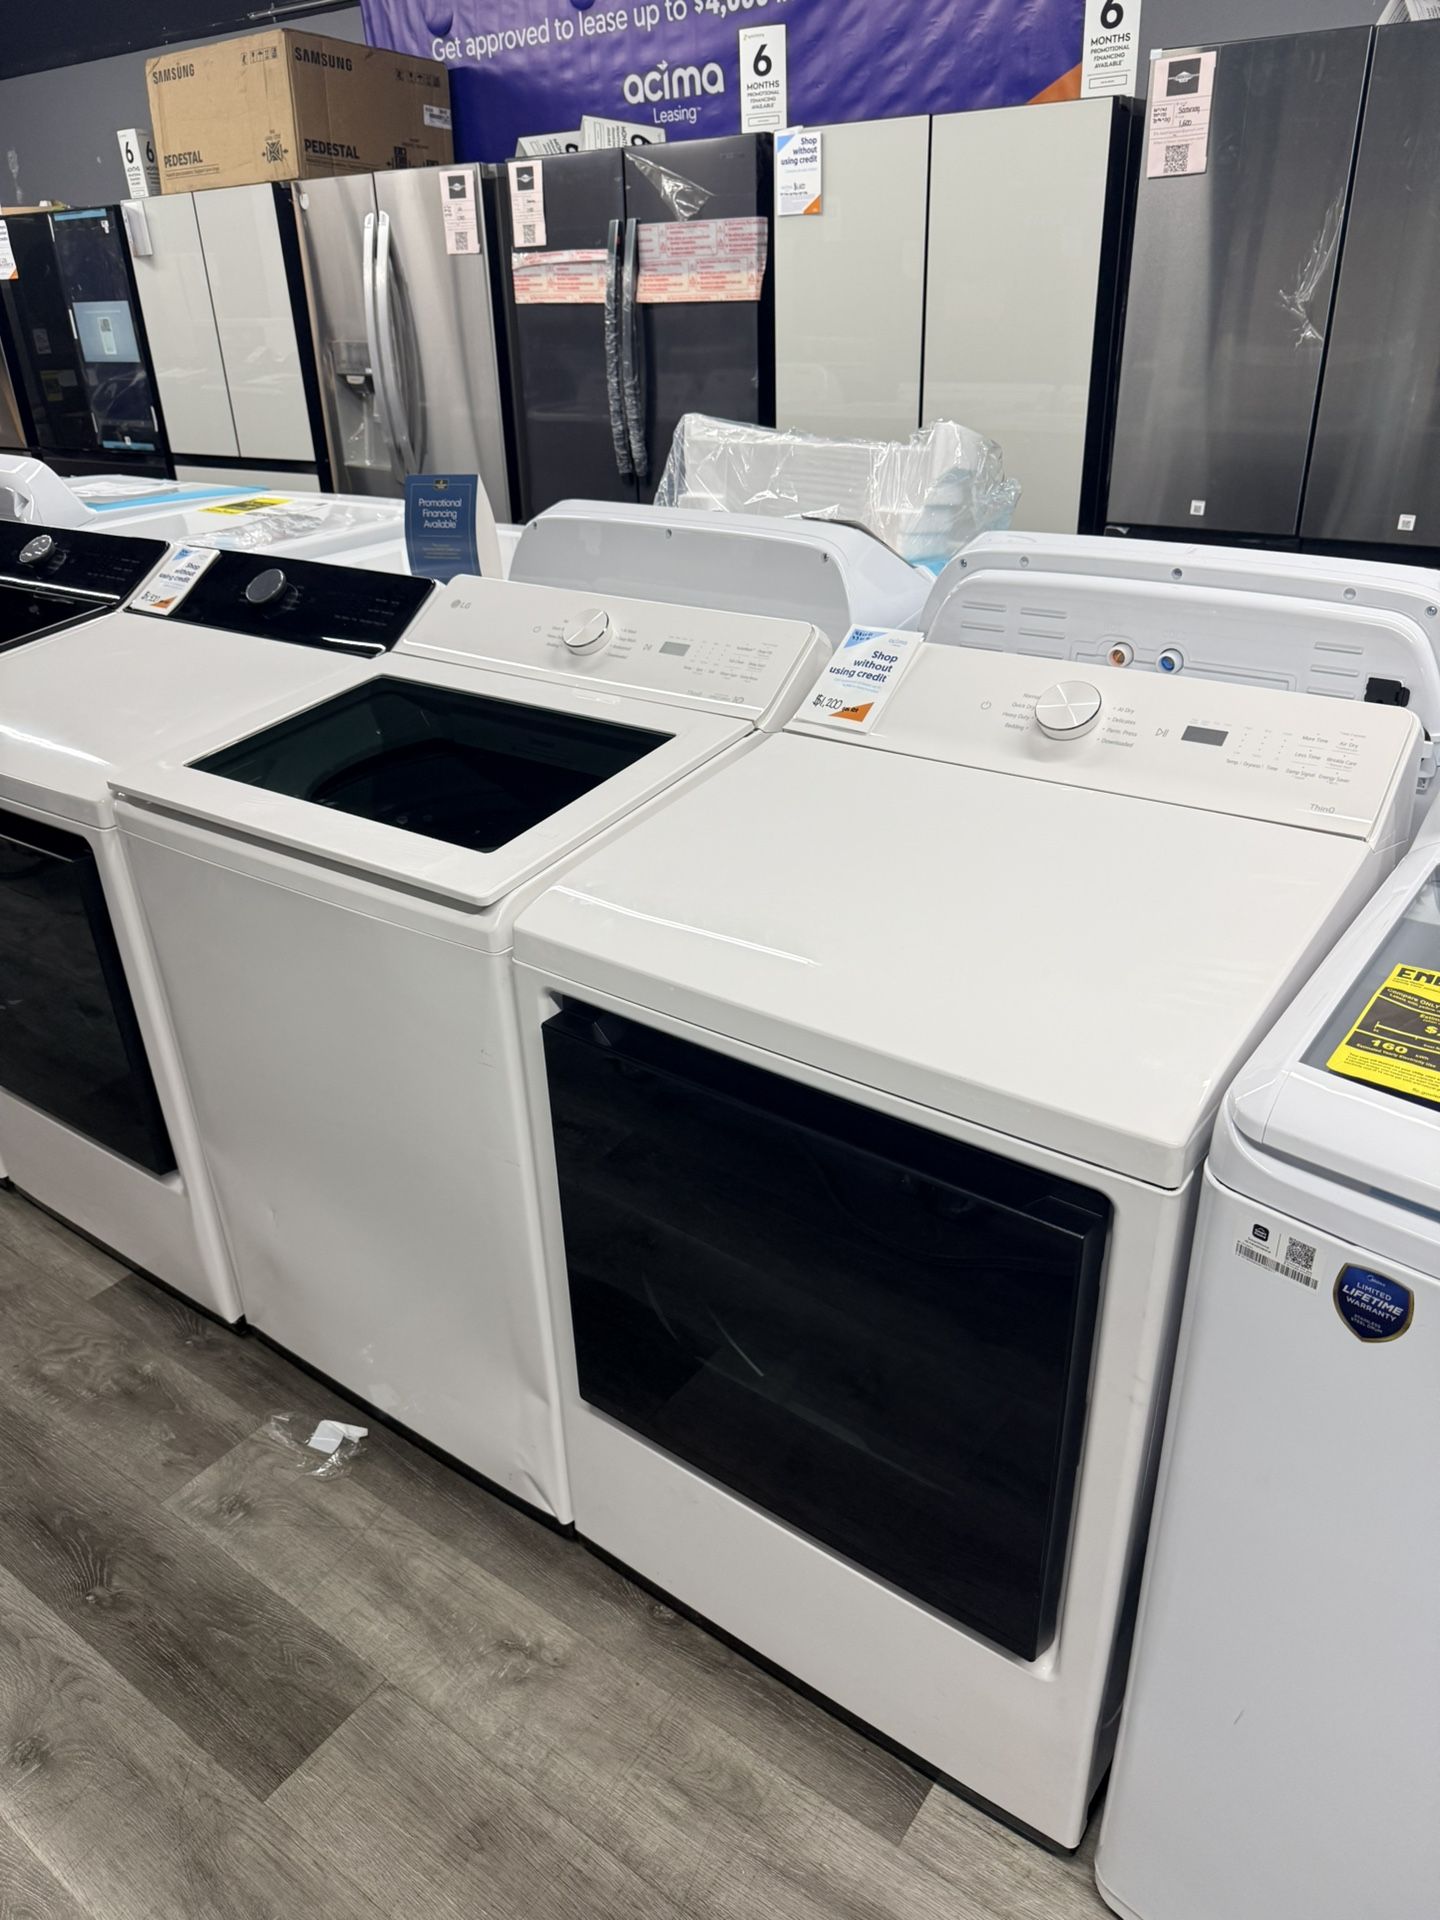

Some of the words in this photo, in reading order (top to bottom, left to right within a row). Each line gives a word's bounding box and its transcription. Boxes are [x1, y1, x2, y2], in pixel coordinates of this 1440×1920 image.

[1100, 0, 1124, 29] 6
[432, 37, 463, 61] Get
[466, 18, 550, 60] approved
[554, 18, 574, 40] to
[578, 11, 629, 36] lease
[634, 5, 660, 31] up
[665, 1, 687, 21] to
[1090, 33, 1131, 46] MONTHS
[1090, 45, 1130, 54] PROMOTIONAL
[1094, 52, 1125, 61] FINANCING
[294, 47, 353, 72] SAMSUNG
[753, 44, 772, 77] 6
[152, 63, 195, 84] SAMSUNG
[623, 60, 725, 104] acima
[746, 80, 780, 91] MONTHS
[304, 139, 360, 160] PEDESTAL
[800, 137, 818, 147] Shop
[125, 141, 134, 164] 6
[146, 141, 155, 163] 6
[793, 146, 818, 155] without
[164, 150, 203, 168] PEDESTAL
[781, 157, 798, 166] using
[799, 155, 818, 164] credit
[418, 498, 462, 507] Promotional
[422, 509, 458, 520] Financing
[460, 602, 471, 610] LG
[871, 650, 898, 664] Shop
[853, 659, 893, 673] without
[829, 666, 856, 678] using
[857, 670, 887, 683] credit
[1387, 988, 1419, 1002] Compare
[1371, 1039, 1408, 1054] 160
[1356, 1281, 1392, 1301] LIMITED
[1342, 1284, 1404, 1317] LIFETIME
[1346, 1295, 1397, 1322] WARRANTY
